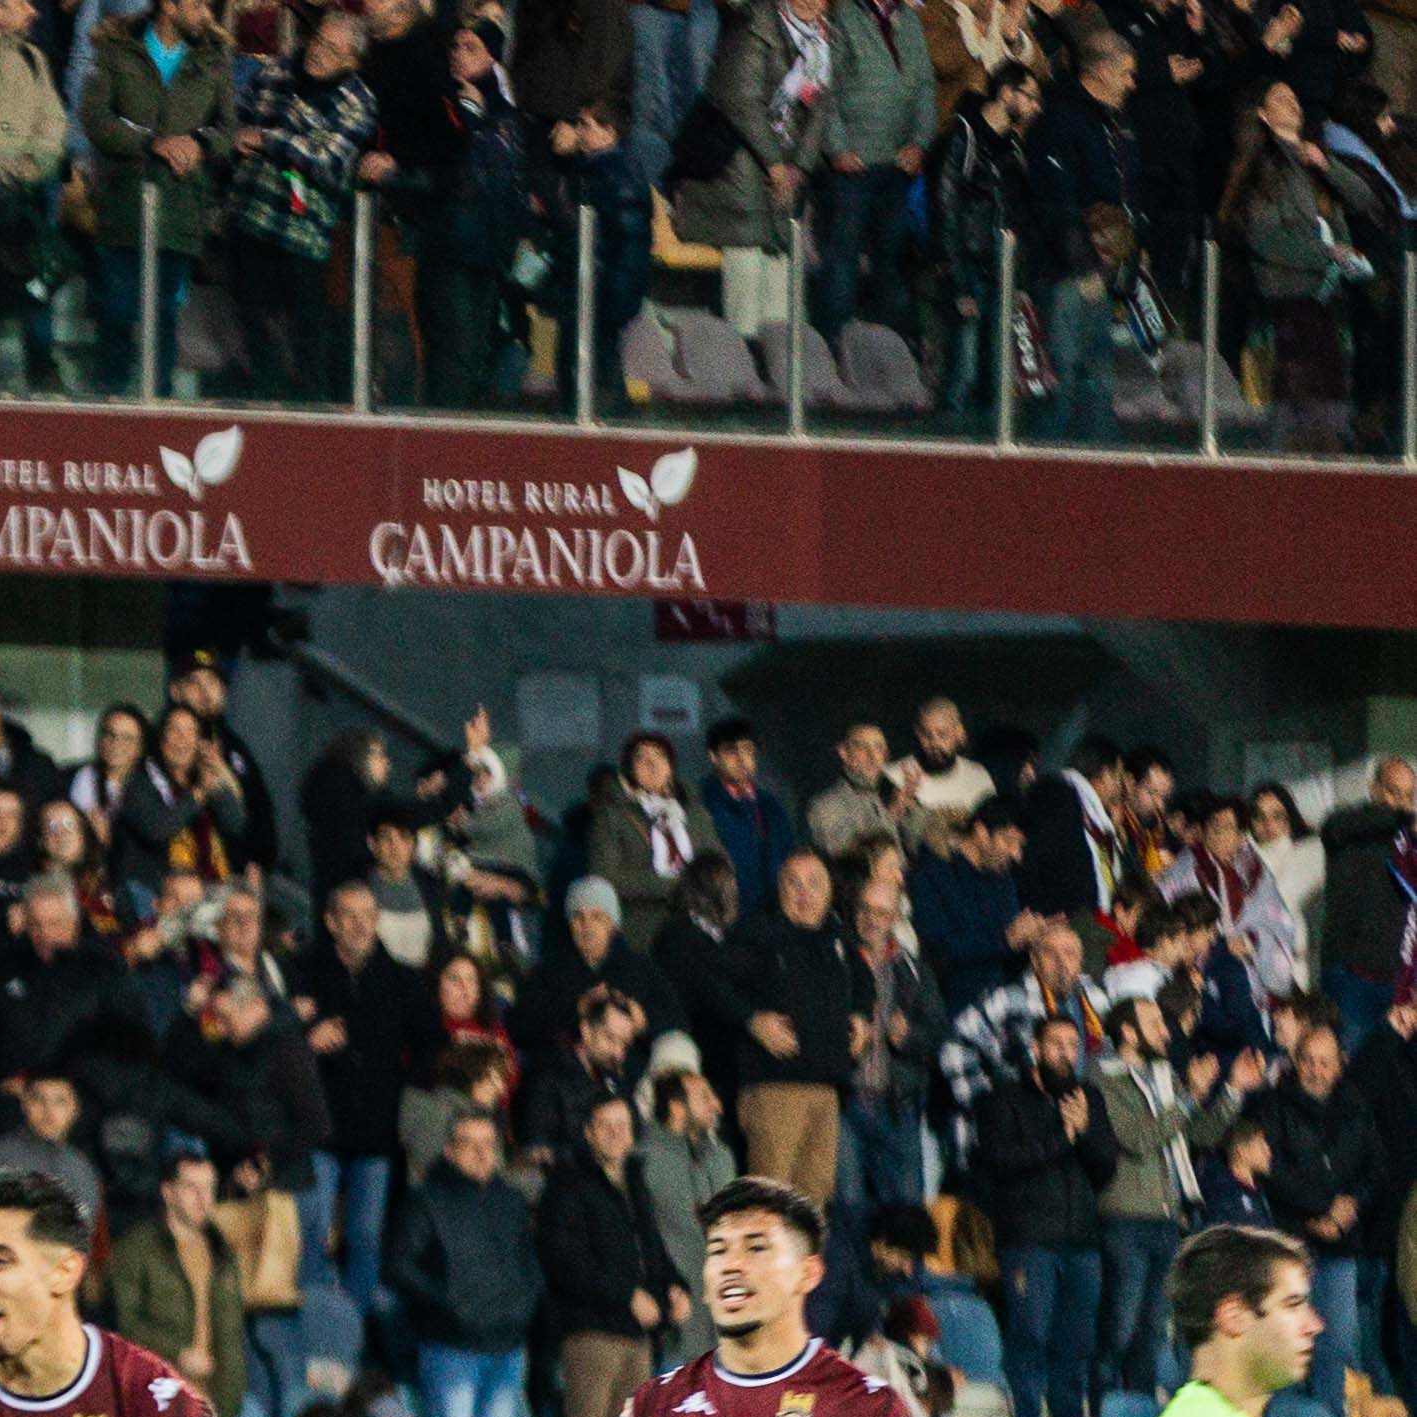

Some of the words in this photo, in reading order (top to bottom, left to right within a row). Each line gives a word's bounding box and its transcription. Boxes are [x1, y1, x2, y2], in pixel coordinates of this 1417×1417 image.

[63, 461, 159, 497] RURAL
[422, 478, 516, 513] HOTEL
[524, 481, 619, 517] RURAL
[369, 522, 707, 592] CAMPANIOLA
